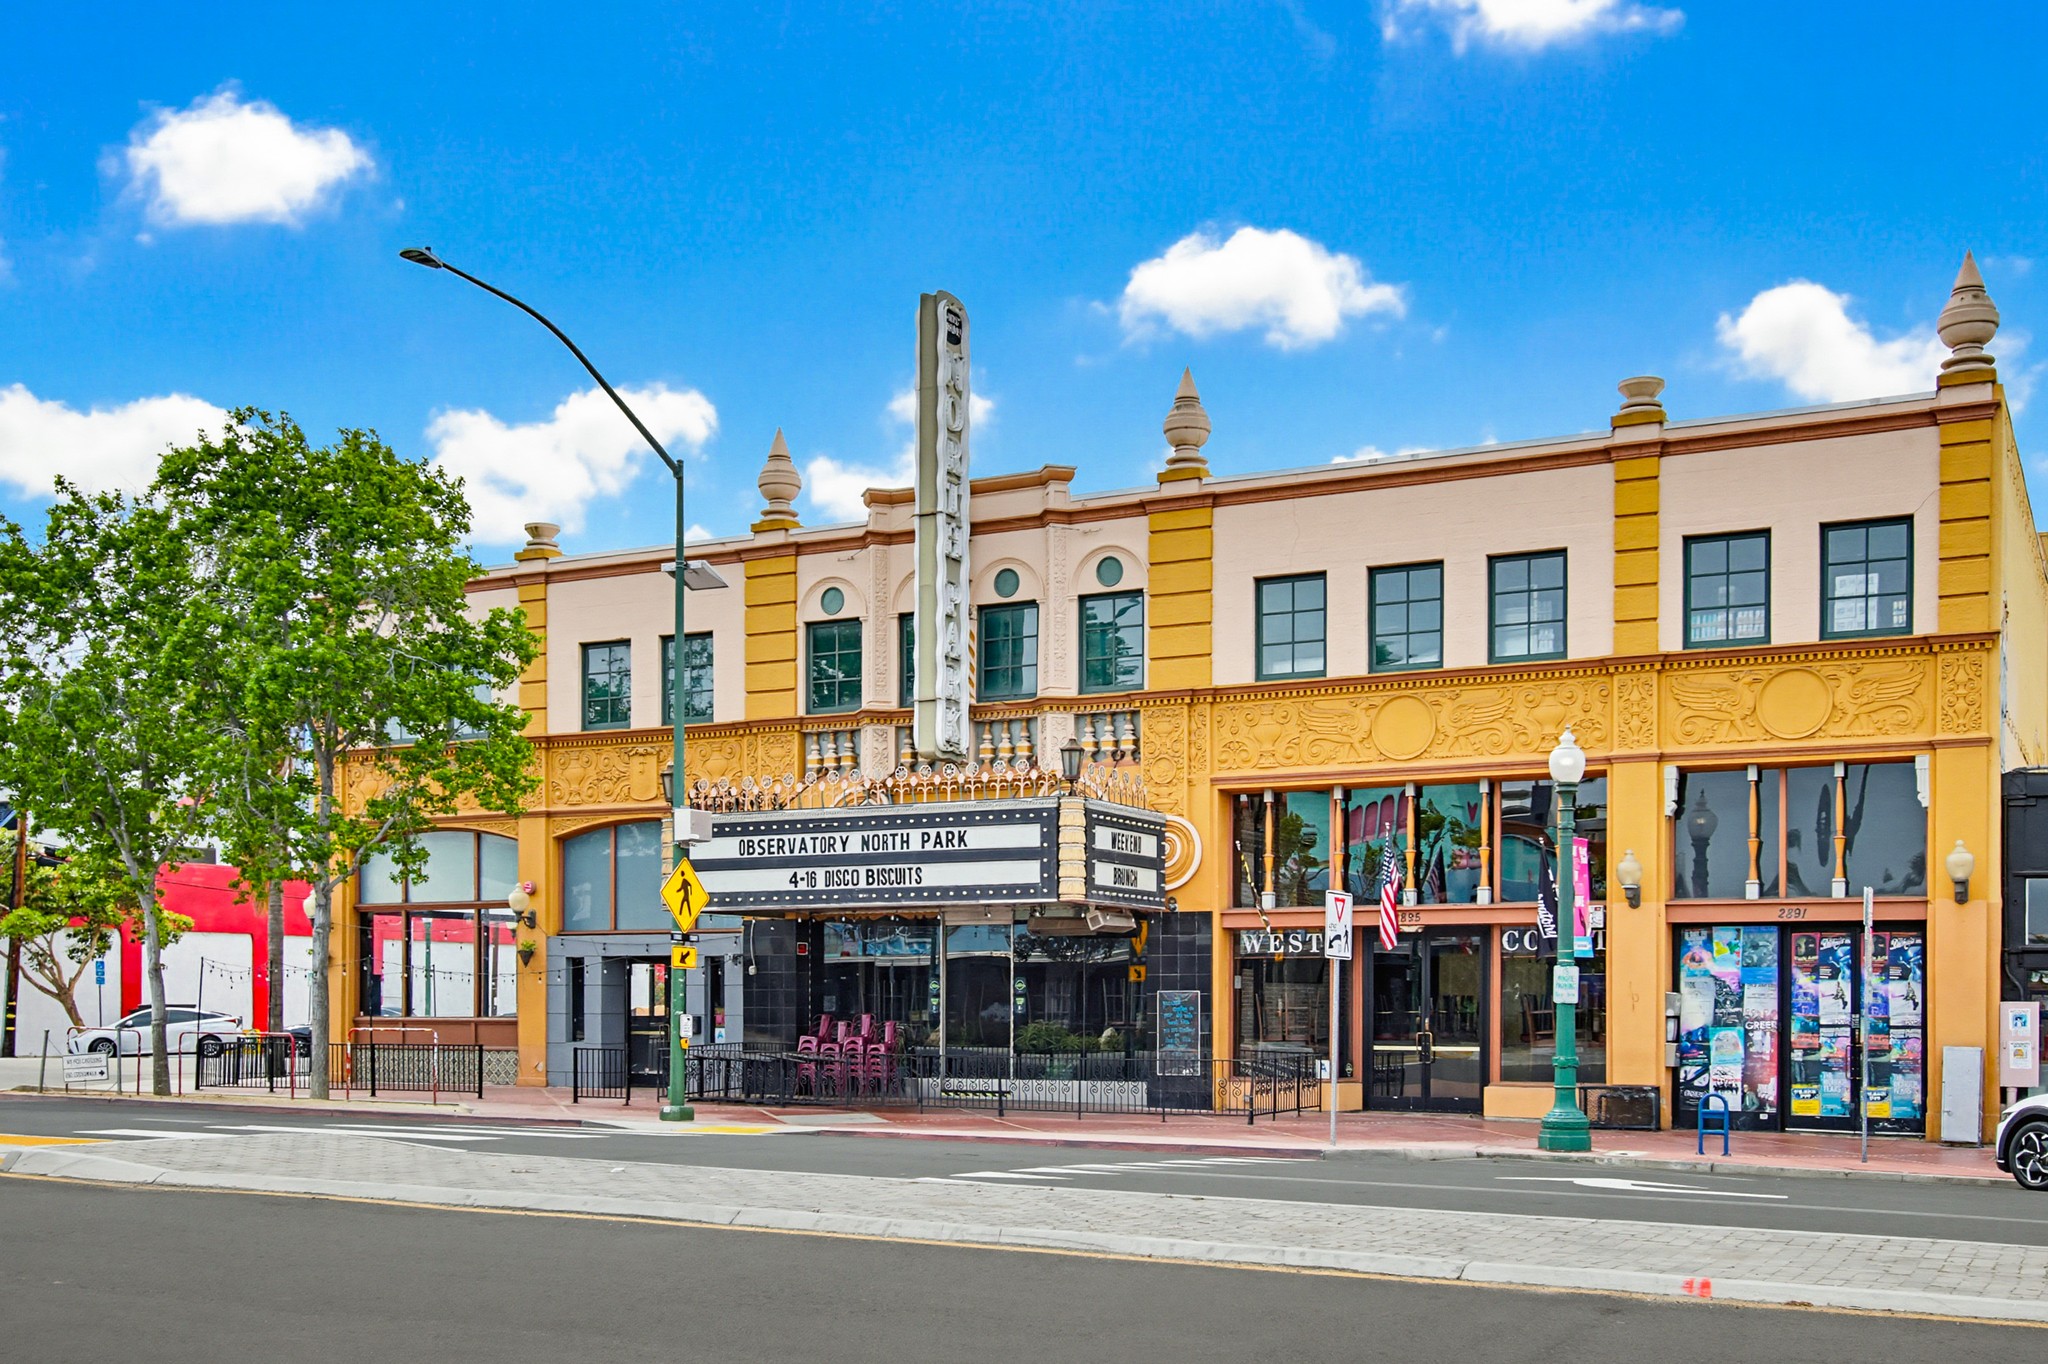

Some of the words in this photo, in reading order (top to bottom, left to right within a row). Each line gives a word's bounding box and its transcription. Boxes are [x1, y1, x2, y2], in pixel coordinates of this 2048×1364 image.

[739, 835, 849, 856] OBSERVATORY
[861, 832, 910, 852] NORTH
[920, 830, 968, 849] PARK
[1111, 831, 1141, 854] WEEKEND
[789, 871, 817, 888] 4-16
[825, 869, 859, 888] DISCO
[866, 867, 922, 886] BISCUITS
[1113, 866, 1138, 888] BRUNCH
[1399, 912, 1420, 922] 895
[1778, 907, 1807, 919] 2891
[1242, 933, 1324, 953] WEST
[1502, 927, 1606, 951] COT
